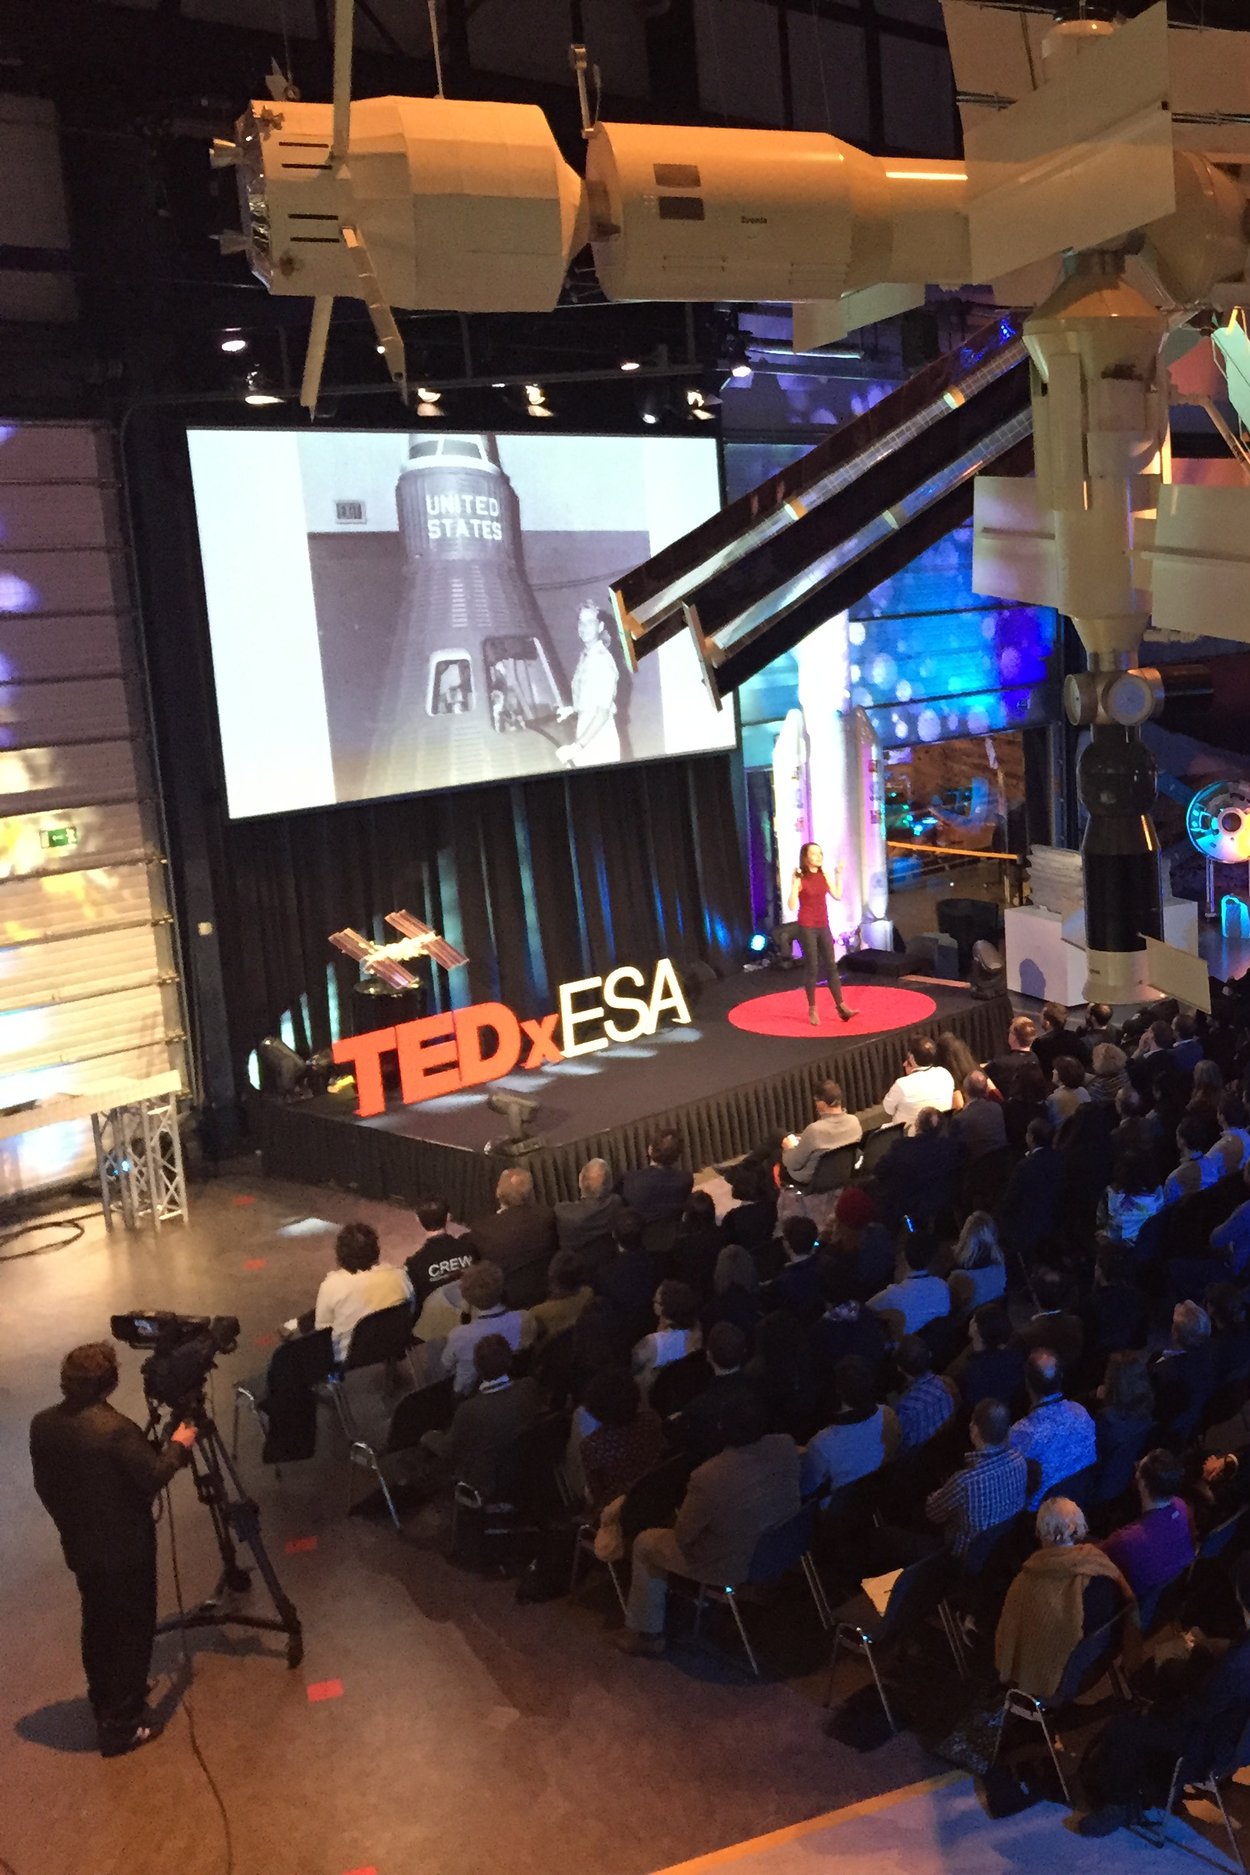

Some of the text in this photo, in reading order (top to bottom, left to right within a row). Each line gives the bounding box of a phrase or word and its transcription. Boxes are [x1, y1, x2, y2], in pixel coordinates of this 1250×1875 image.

[425, 493, 499, 518] UNITED
[427, 518, 502, 541] STATES
[428, 1255, 472, 1277] CREW
